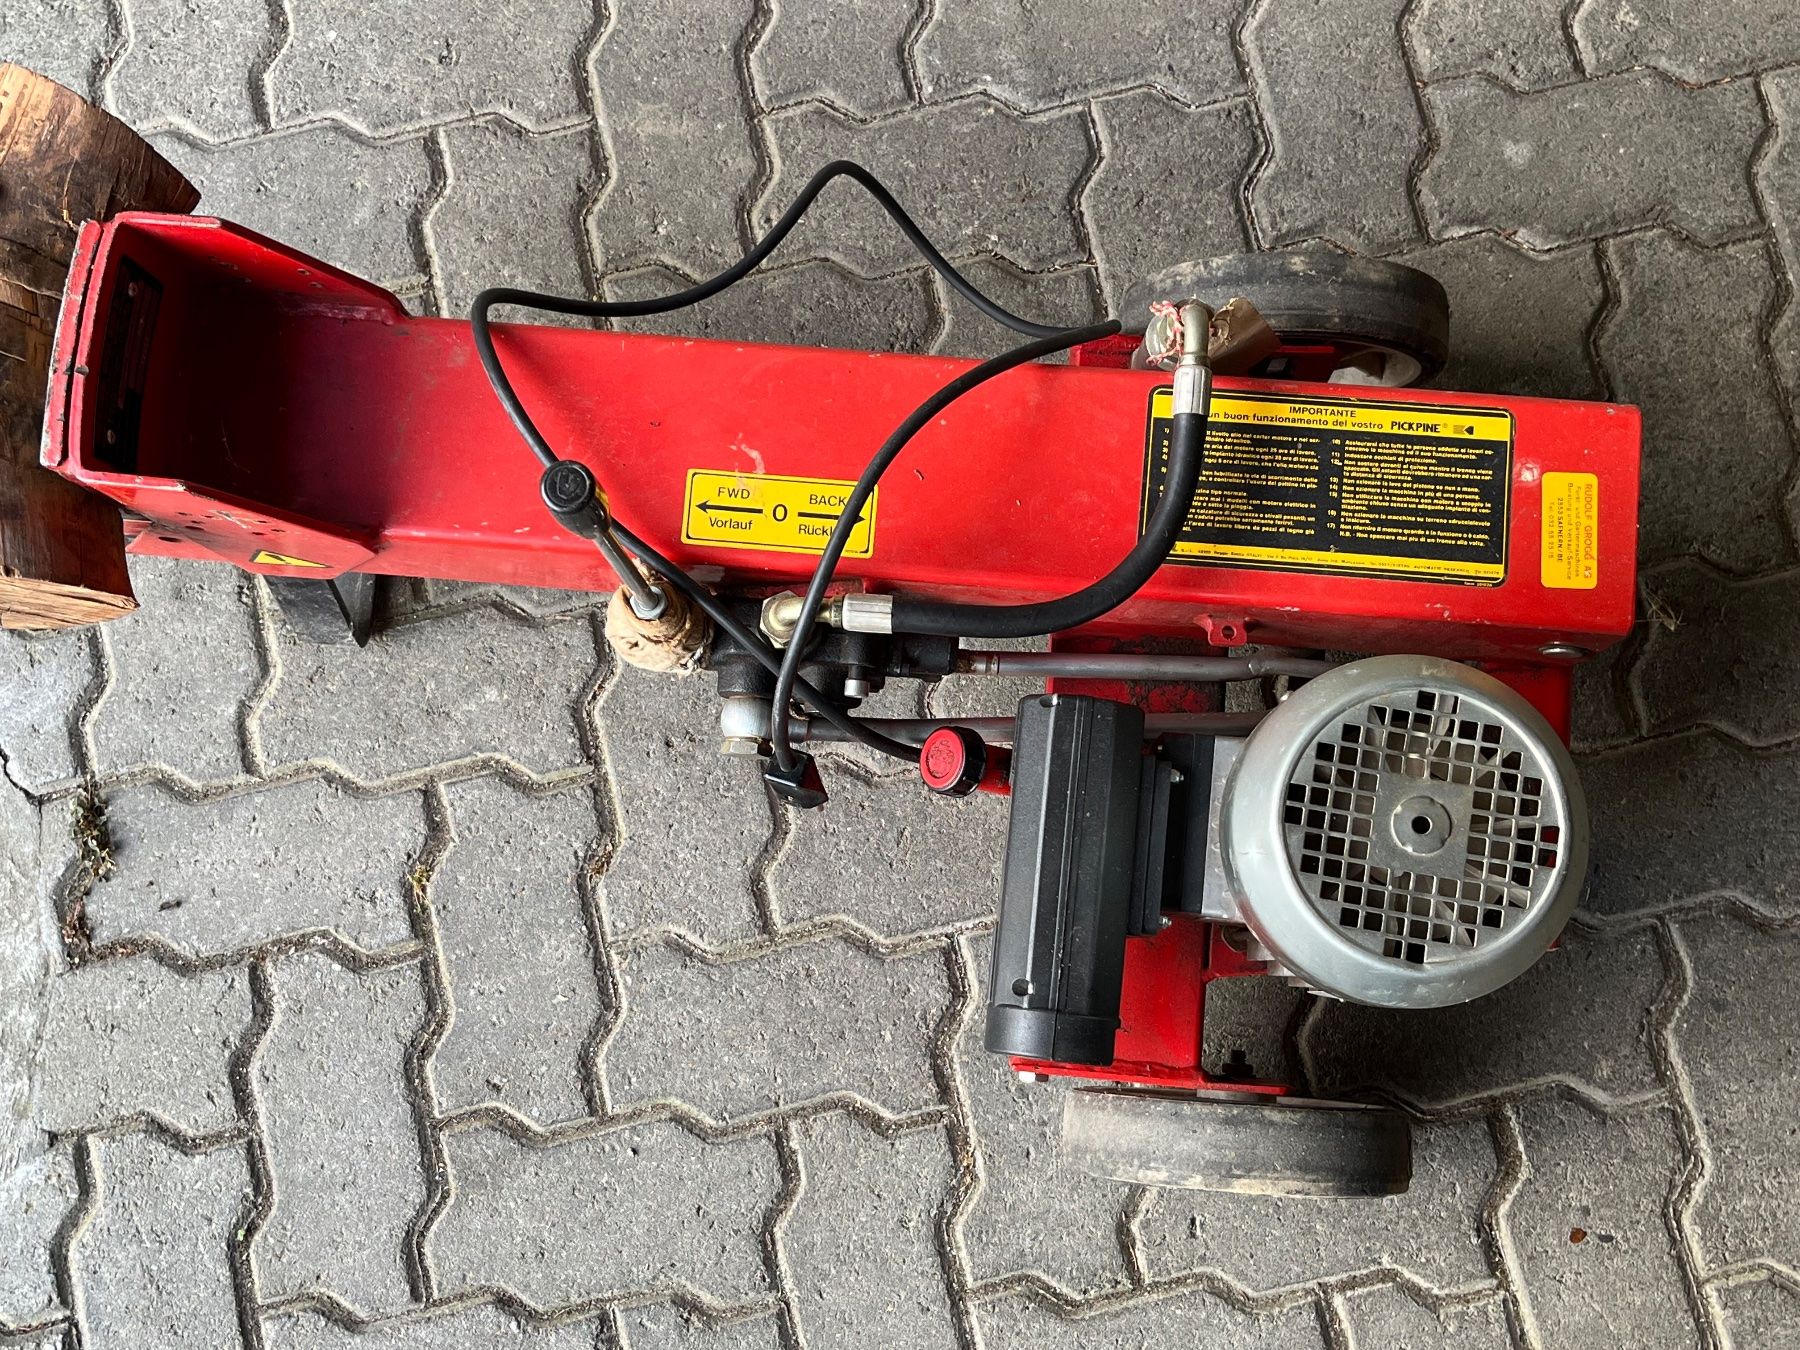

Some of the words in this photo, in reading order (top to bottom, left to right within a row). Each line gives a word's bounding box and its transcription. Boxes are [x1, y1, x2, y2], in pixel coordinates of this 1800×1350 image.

[1289, 406, 1356, 418] IMPORTANTE
[1223, 412, 1248, 420] buon
[1252, 413, 1328, 425] funzionamento
[1390, 421, 1439, 432] PICKPINE
[717, 487, 750, 500] FWD
[809, 494, 847, 507] BACK
[1584, 484, 1592, 520] RUDOLF
[709, 518, 753, 530] Vorlauf
[1584, 526, 1592, 560] GROGG
